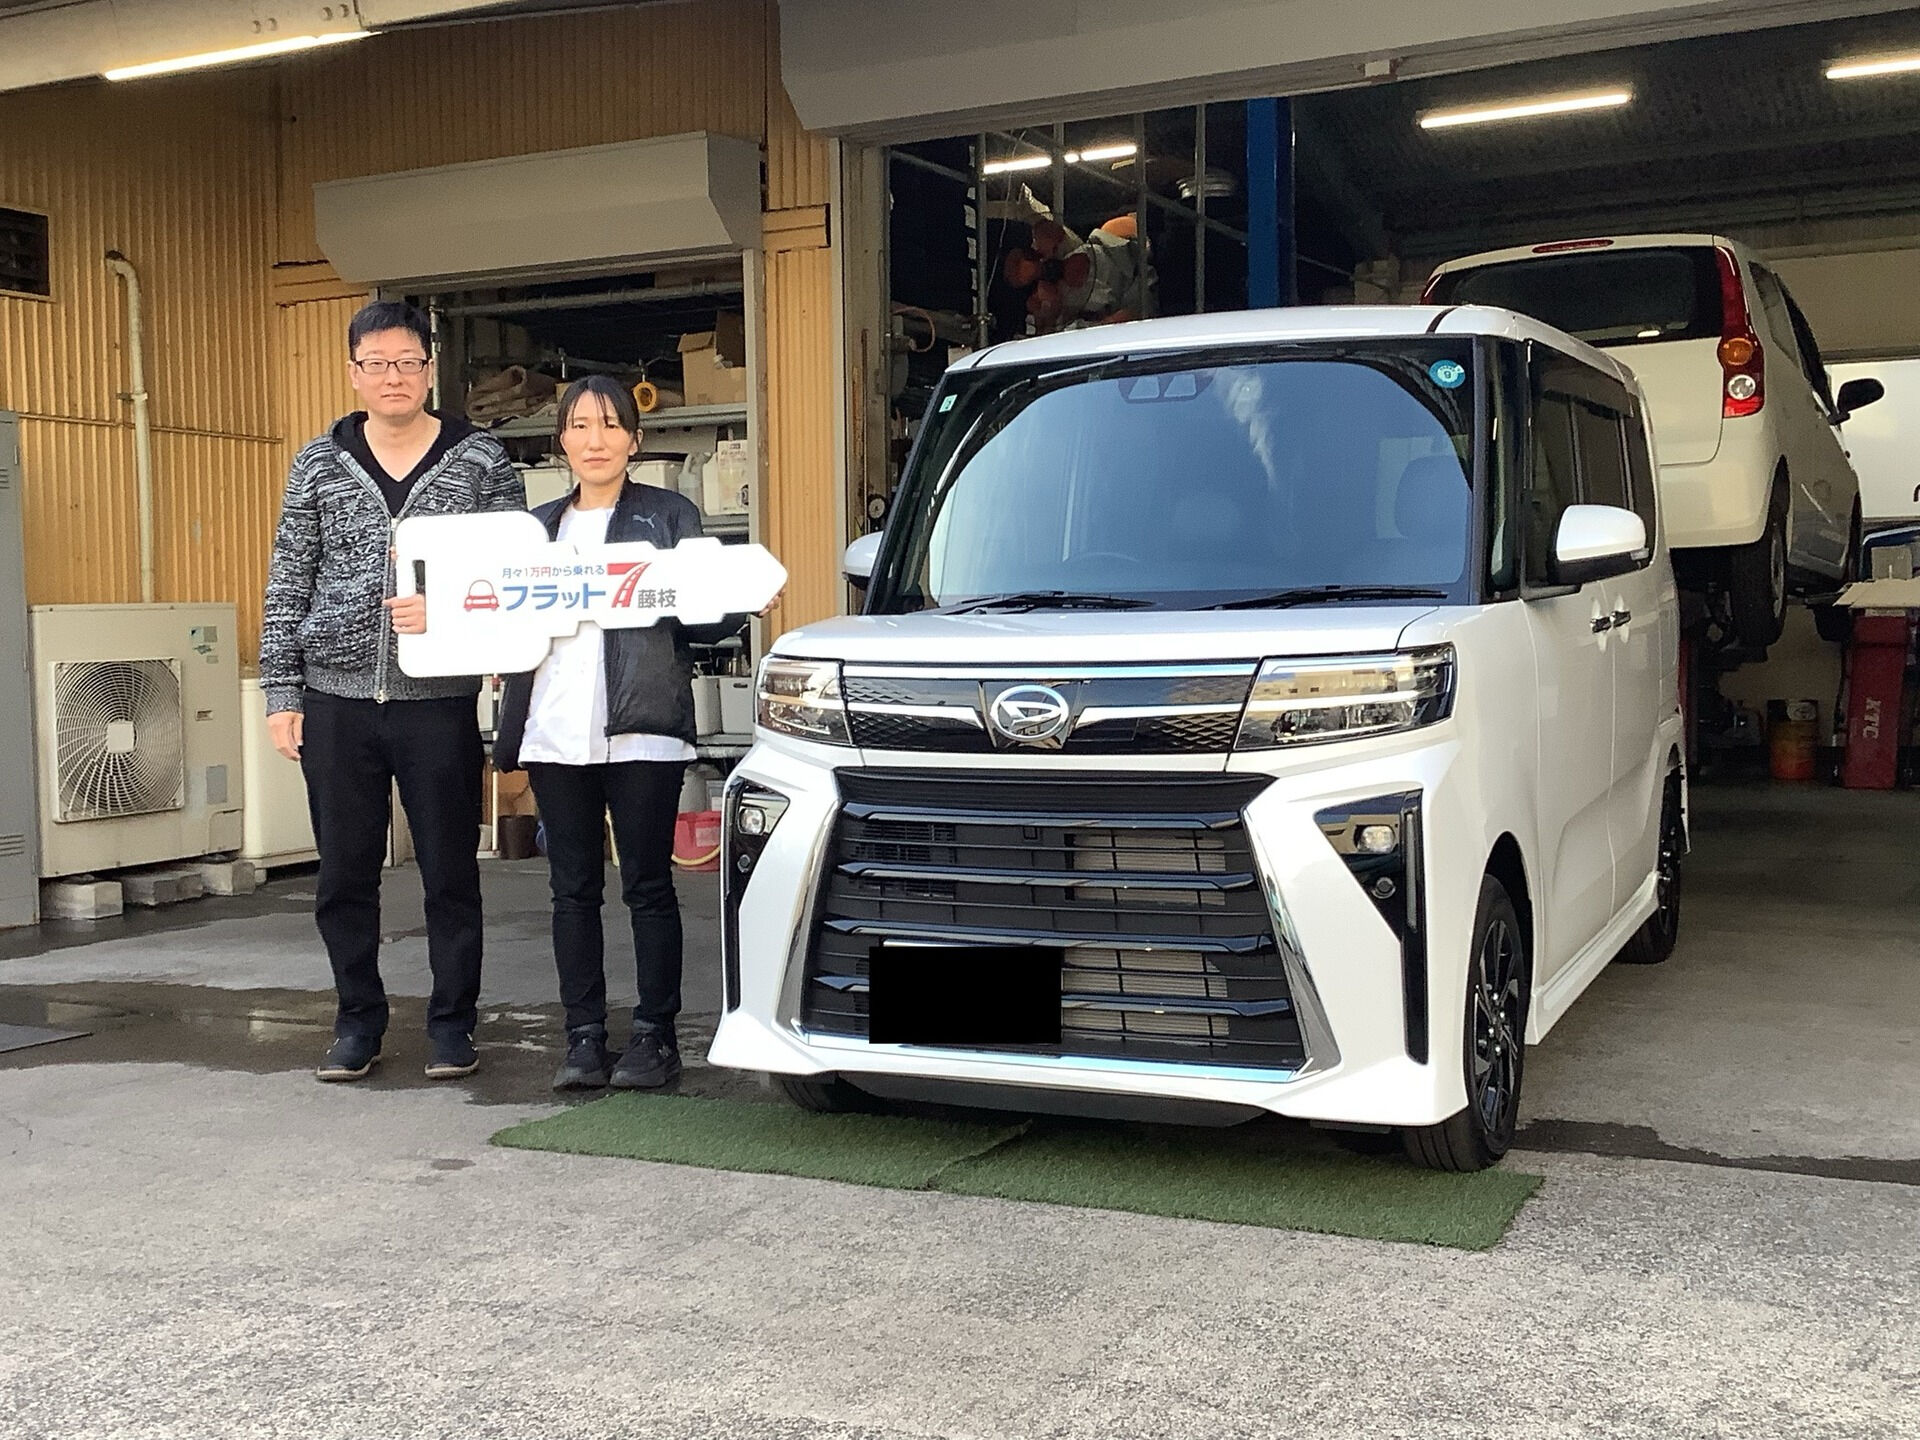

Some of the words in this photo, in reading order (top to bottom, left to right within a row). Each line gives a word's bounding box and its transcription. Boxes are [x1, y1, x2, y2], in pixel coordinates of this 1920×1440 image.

[502, 565, 605, 578] 月々1万円から乗れる
[1862, 697, 1882, 739] KTC
